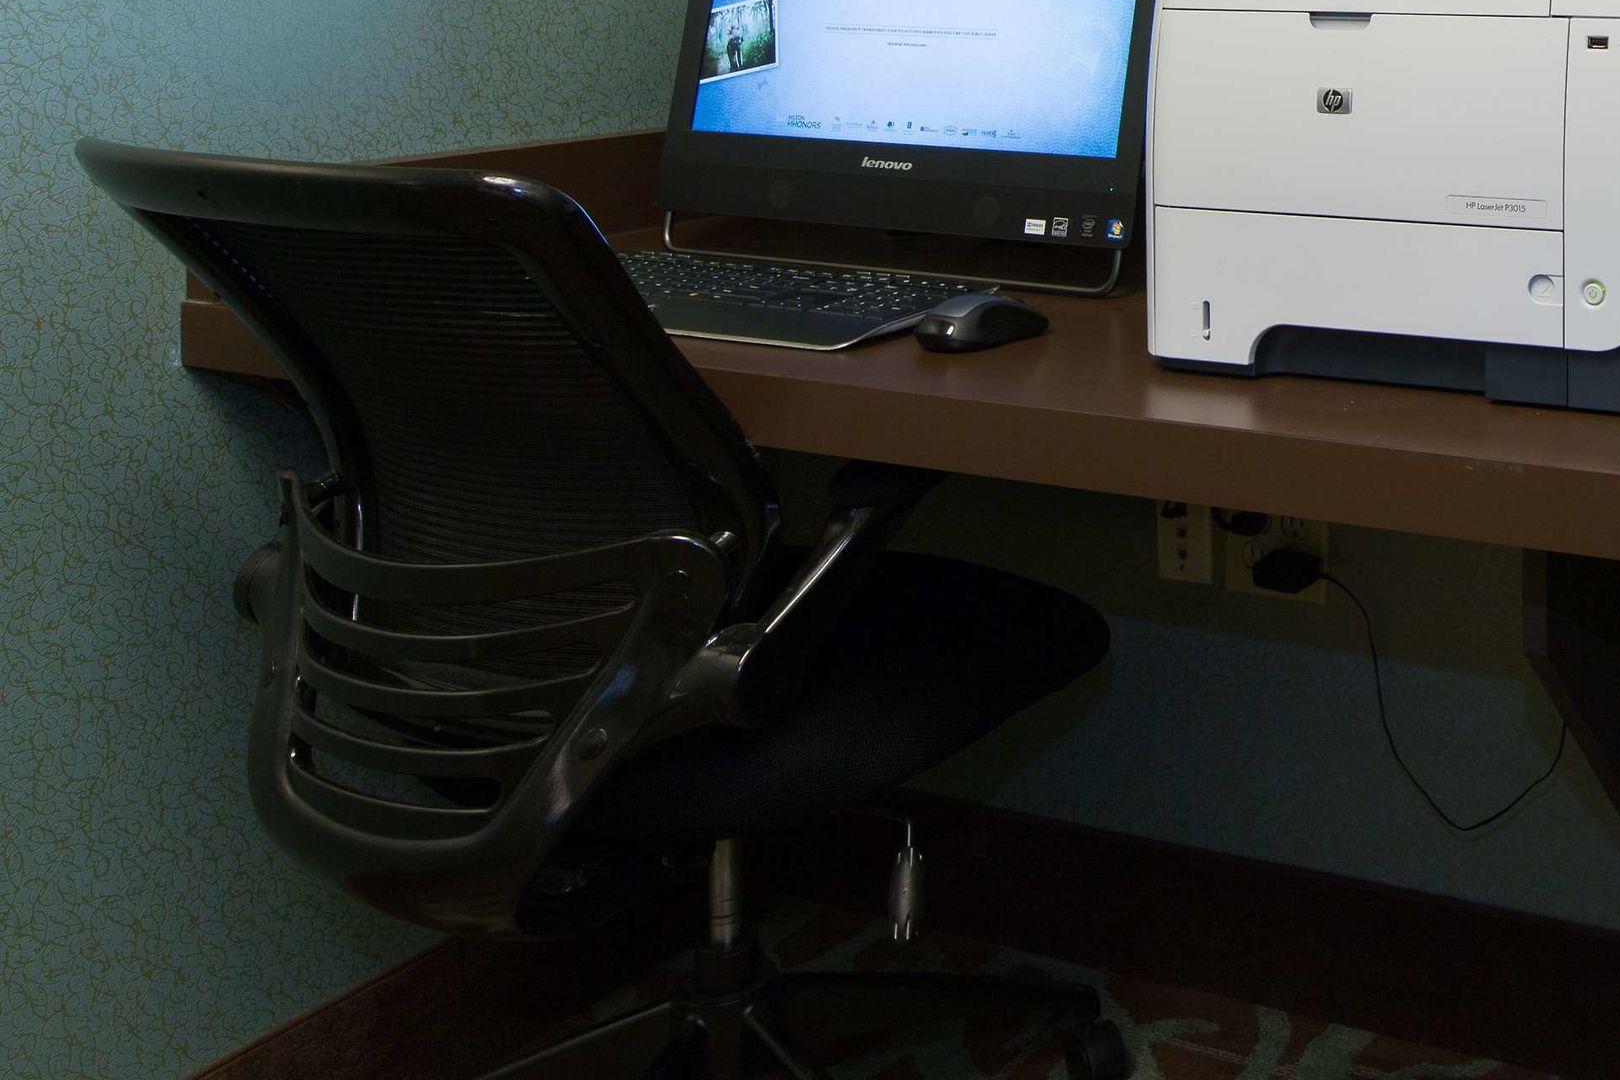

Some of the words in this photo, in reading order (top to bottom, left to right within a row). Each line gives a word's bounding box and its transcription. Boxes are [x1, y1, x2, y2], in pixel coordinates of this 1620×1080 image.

[861, 156, 913, 171] lenovo
[1465, 201, 1476, 209] HP
[1477, 202, 1504, 212] LaserJet
[1504, 203, 1526, 213] P3015
